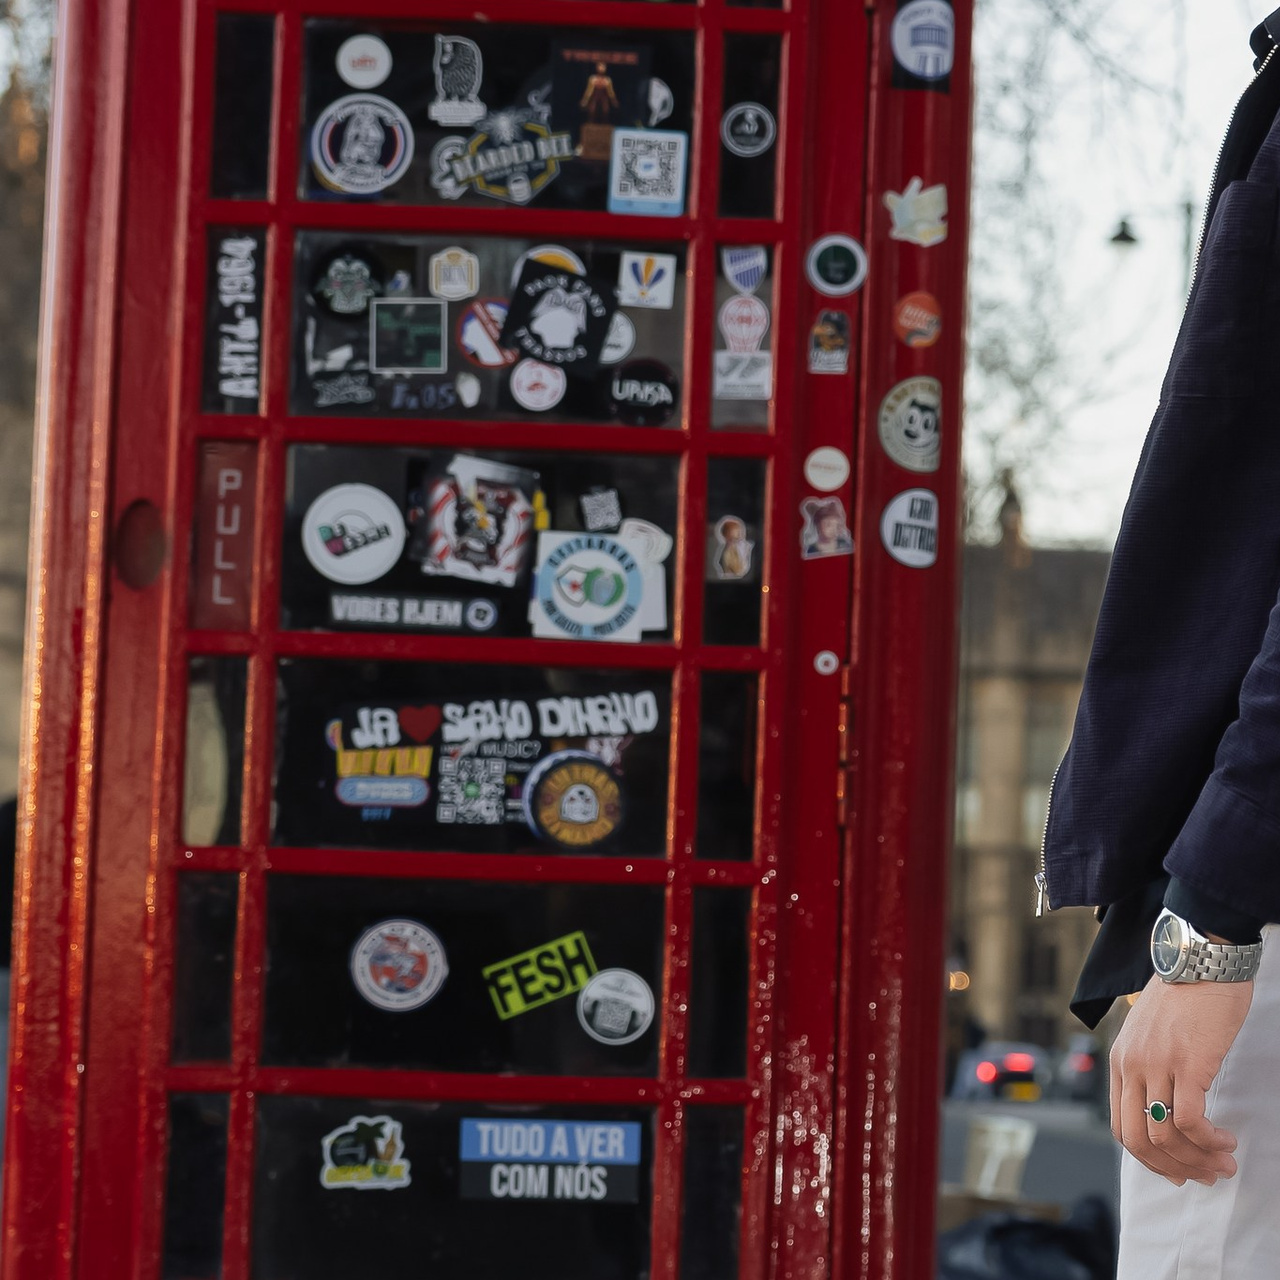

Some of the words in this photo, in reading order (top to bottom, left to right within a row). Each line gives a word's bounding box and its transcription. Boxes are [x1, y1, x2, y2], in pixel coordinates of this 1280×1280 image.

[212, 468, 243, 605] PULL
[351, 706, 400, 749] JA
[491, 938, 593, 1013] FESH
[475, 1123, 545, 1158] TUDO
[551, 1124, 572, 1158] A
[574, 1125, 626, 1159] VER
[490, 1163, 549, 1199] COM
[554, 1161, 608, 1200] NÓS
